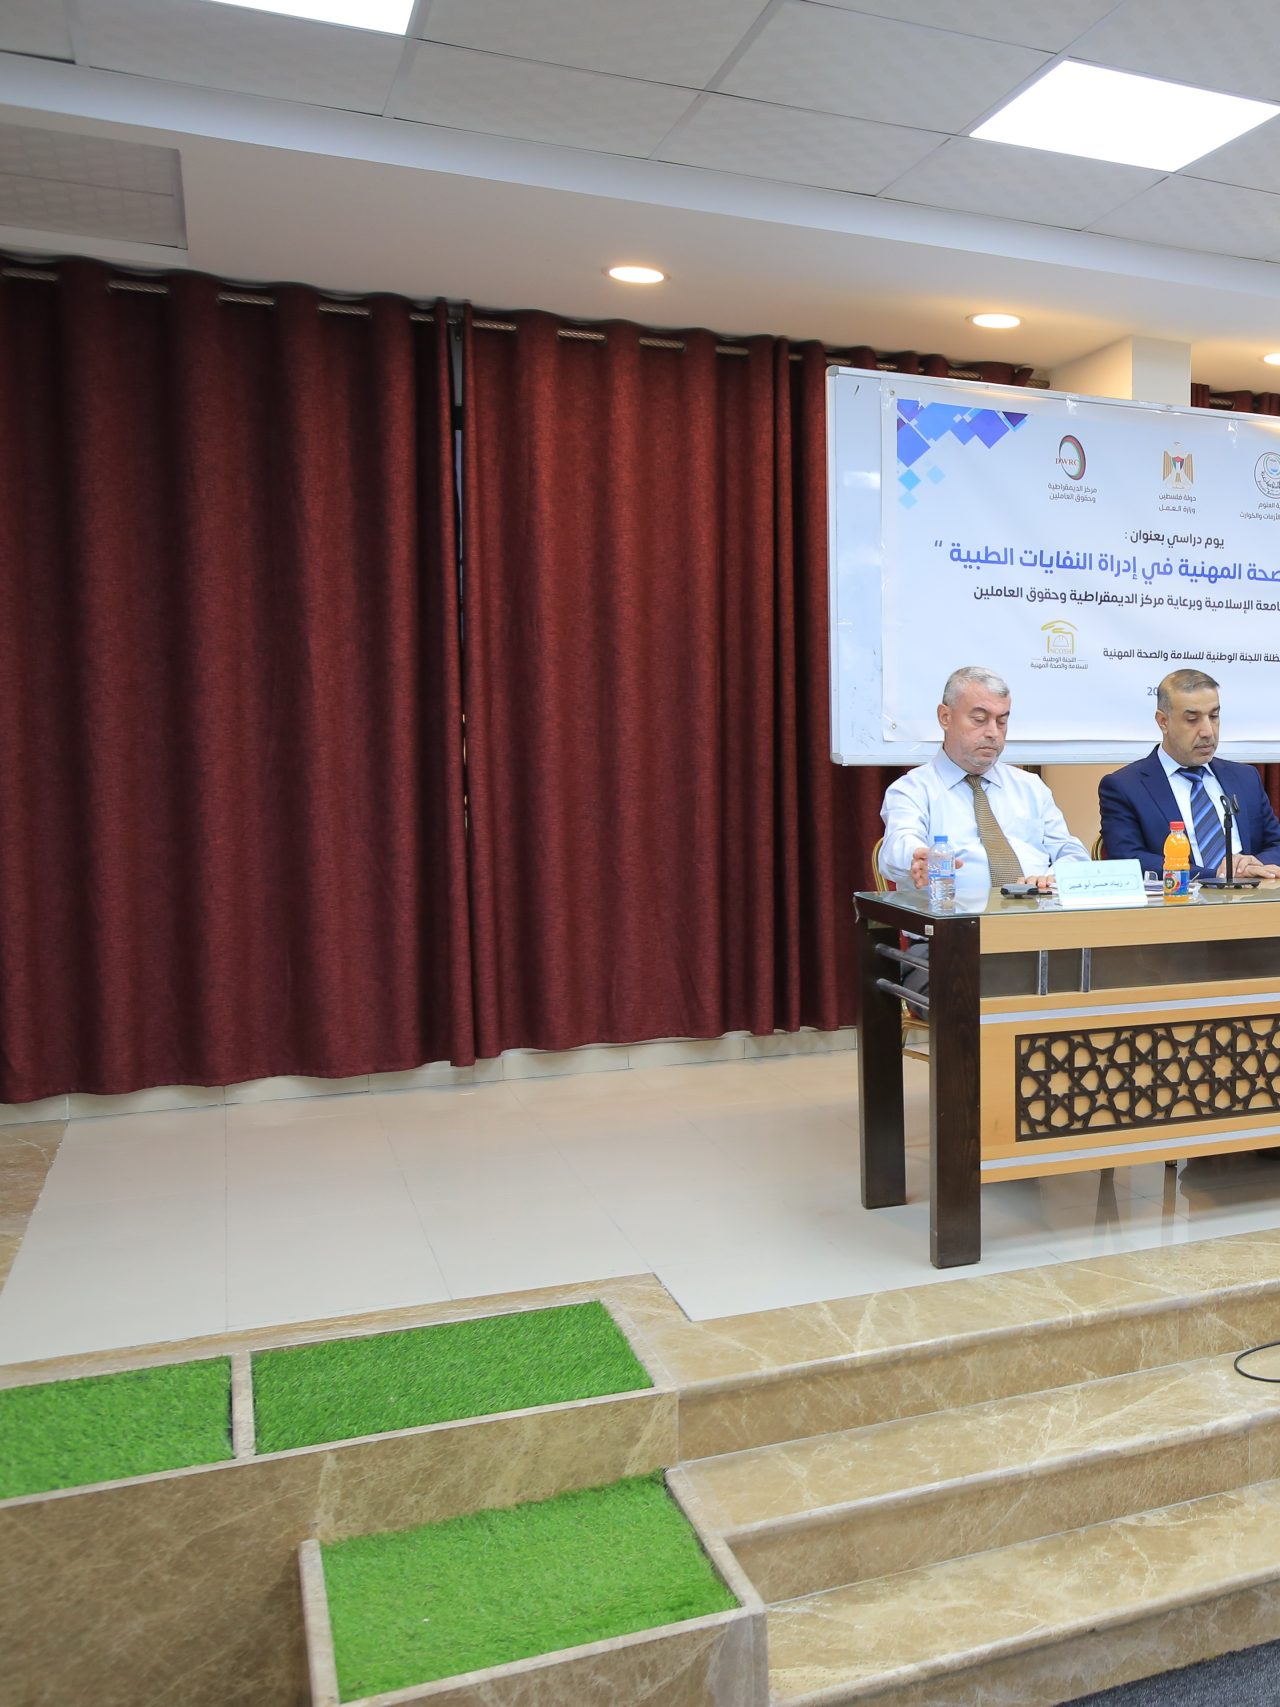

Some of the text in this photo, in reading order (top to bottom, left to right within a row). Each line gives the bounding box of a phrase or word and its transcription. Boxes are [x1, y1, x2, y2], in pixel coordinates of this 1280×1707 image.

[1048, 483, 1097, 494] مركز الديمقراطية
[1049, 492, 1096, 503] وحقوق العاملين
[1182, 505, 1196, 514] وزارة
[1129, 529, 1164, 545] بعنوان
[1166, 533, 1202, 548] دراسي
[1204, 537, 1224, 549] يوم
[949, 542, 1013, 570] الطبية
[1019, 549, 1092, 574] النفايات
[1141, 557, 1173, 584] في
[1178, 558, 1242, 584] المهنية
[973, 585, 1023, 600] العاملين
[1025, 586, 1066, 604] وحقوق
[1069, 588, 1137, 606] الديمقراطية
[1139, 593, 1164, 608] مركز
[1166, 594, 1202, 611] وبرعاية
[1204, 596, 1253, 614] الإسلامية
[1102, 647, 1134, 660] المهنية
[1136, 648, 1168, 661] والصحة
[1170, 649, 1204, 660] للسلامة
[1205, 651, 1237, 663] الوطنية
[1239, 652, 1262, 663] اللجنة
